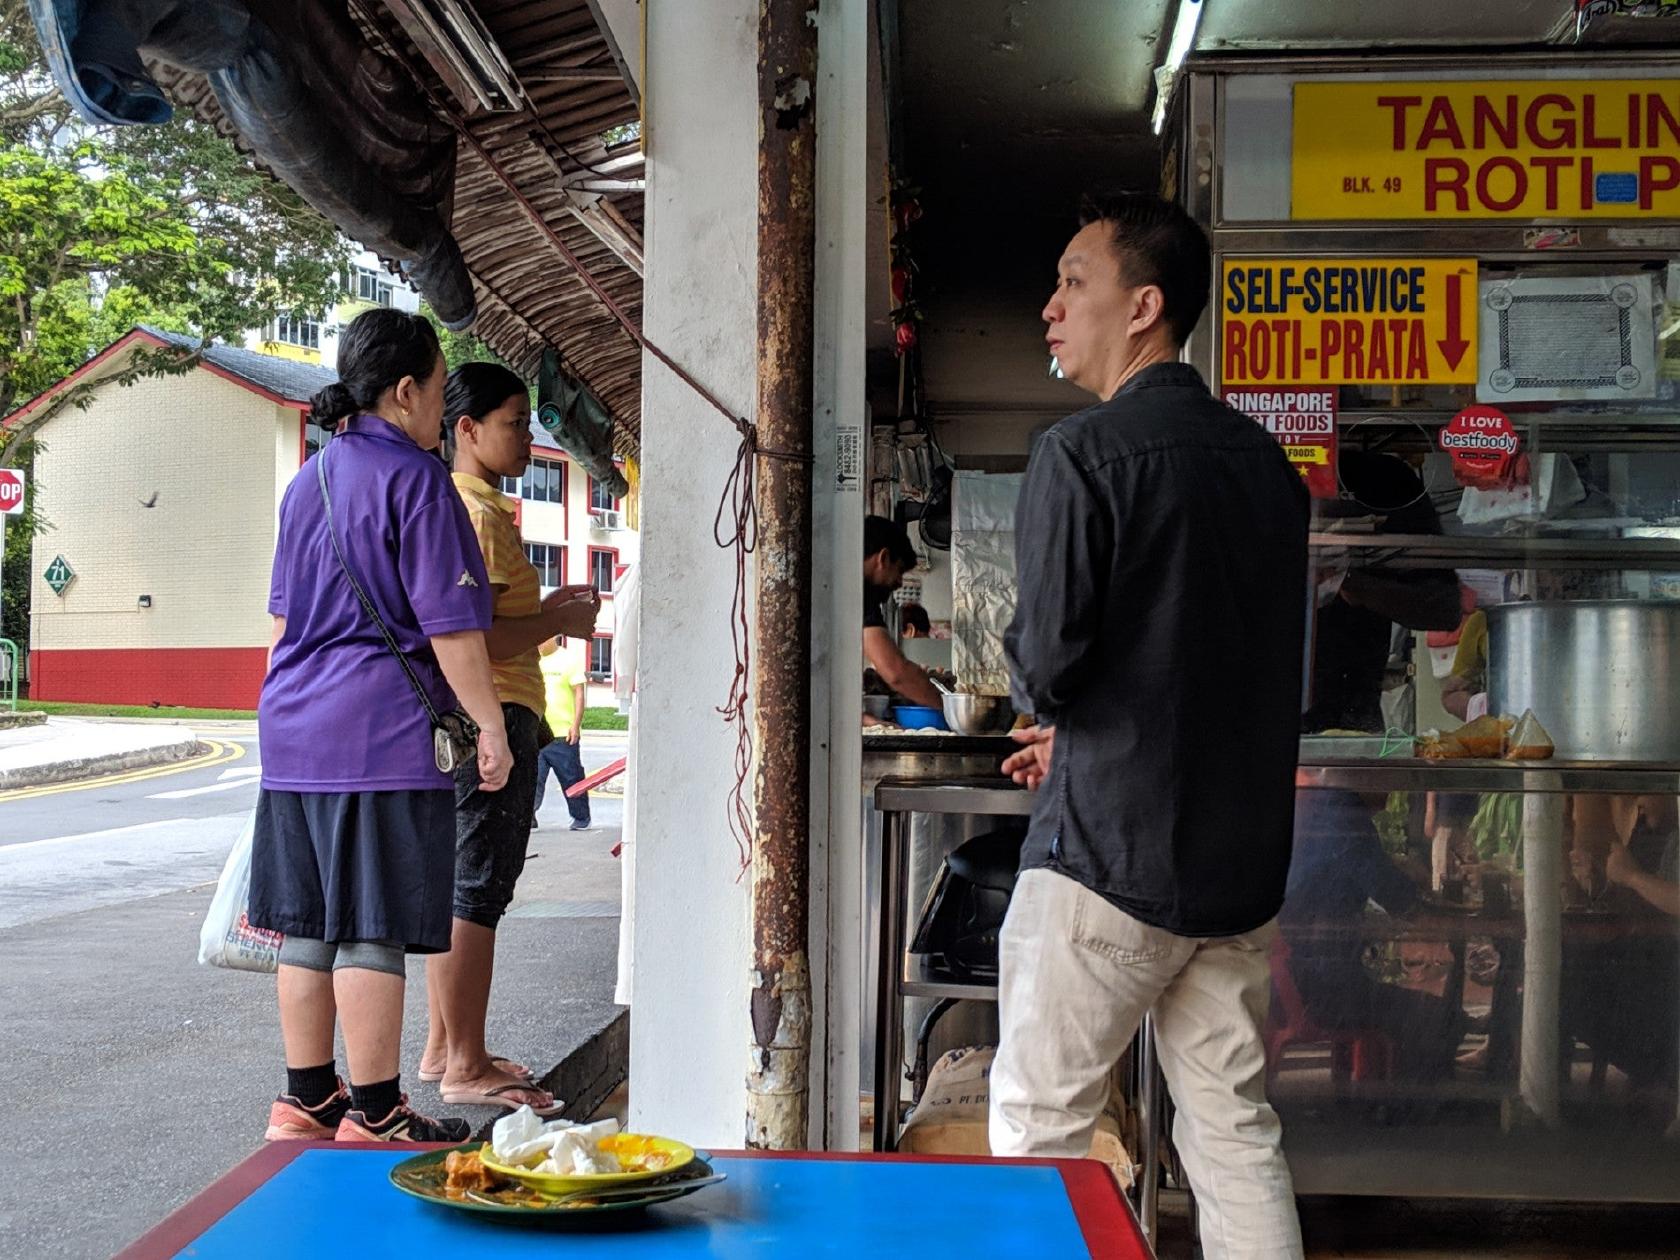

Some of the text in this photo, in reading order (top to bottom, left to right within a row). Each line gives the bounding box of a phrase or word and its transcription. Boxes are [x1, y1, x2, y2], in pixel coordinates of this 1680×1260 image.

[1377, 93, 1680, 151] TANGLIN
[1343, 177, 1402, 194] BLK. 49
[1424, 156, 1594, 212] ROTI
[1638, 155, 1680, 210] P
[1227, 266, 1426, 314] SELF-SERVICE
[1225, 319, 1429, 380] ROTI-PRATA
[1225, 392, 1333, 412] SINGAPORE
[1275, 414, 1329, 431] FOODS
[1460, 416, 1503, 428] I LOVE
[1442, 431, 1517, 453] bestfoody
[1287, 448, 1316, 457] FOODS
[0, 483, 21, 500] OP
[51, 565, 65, 580] 71
